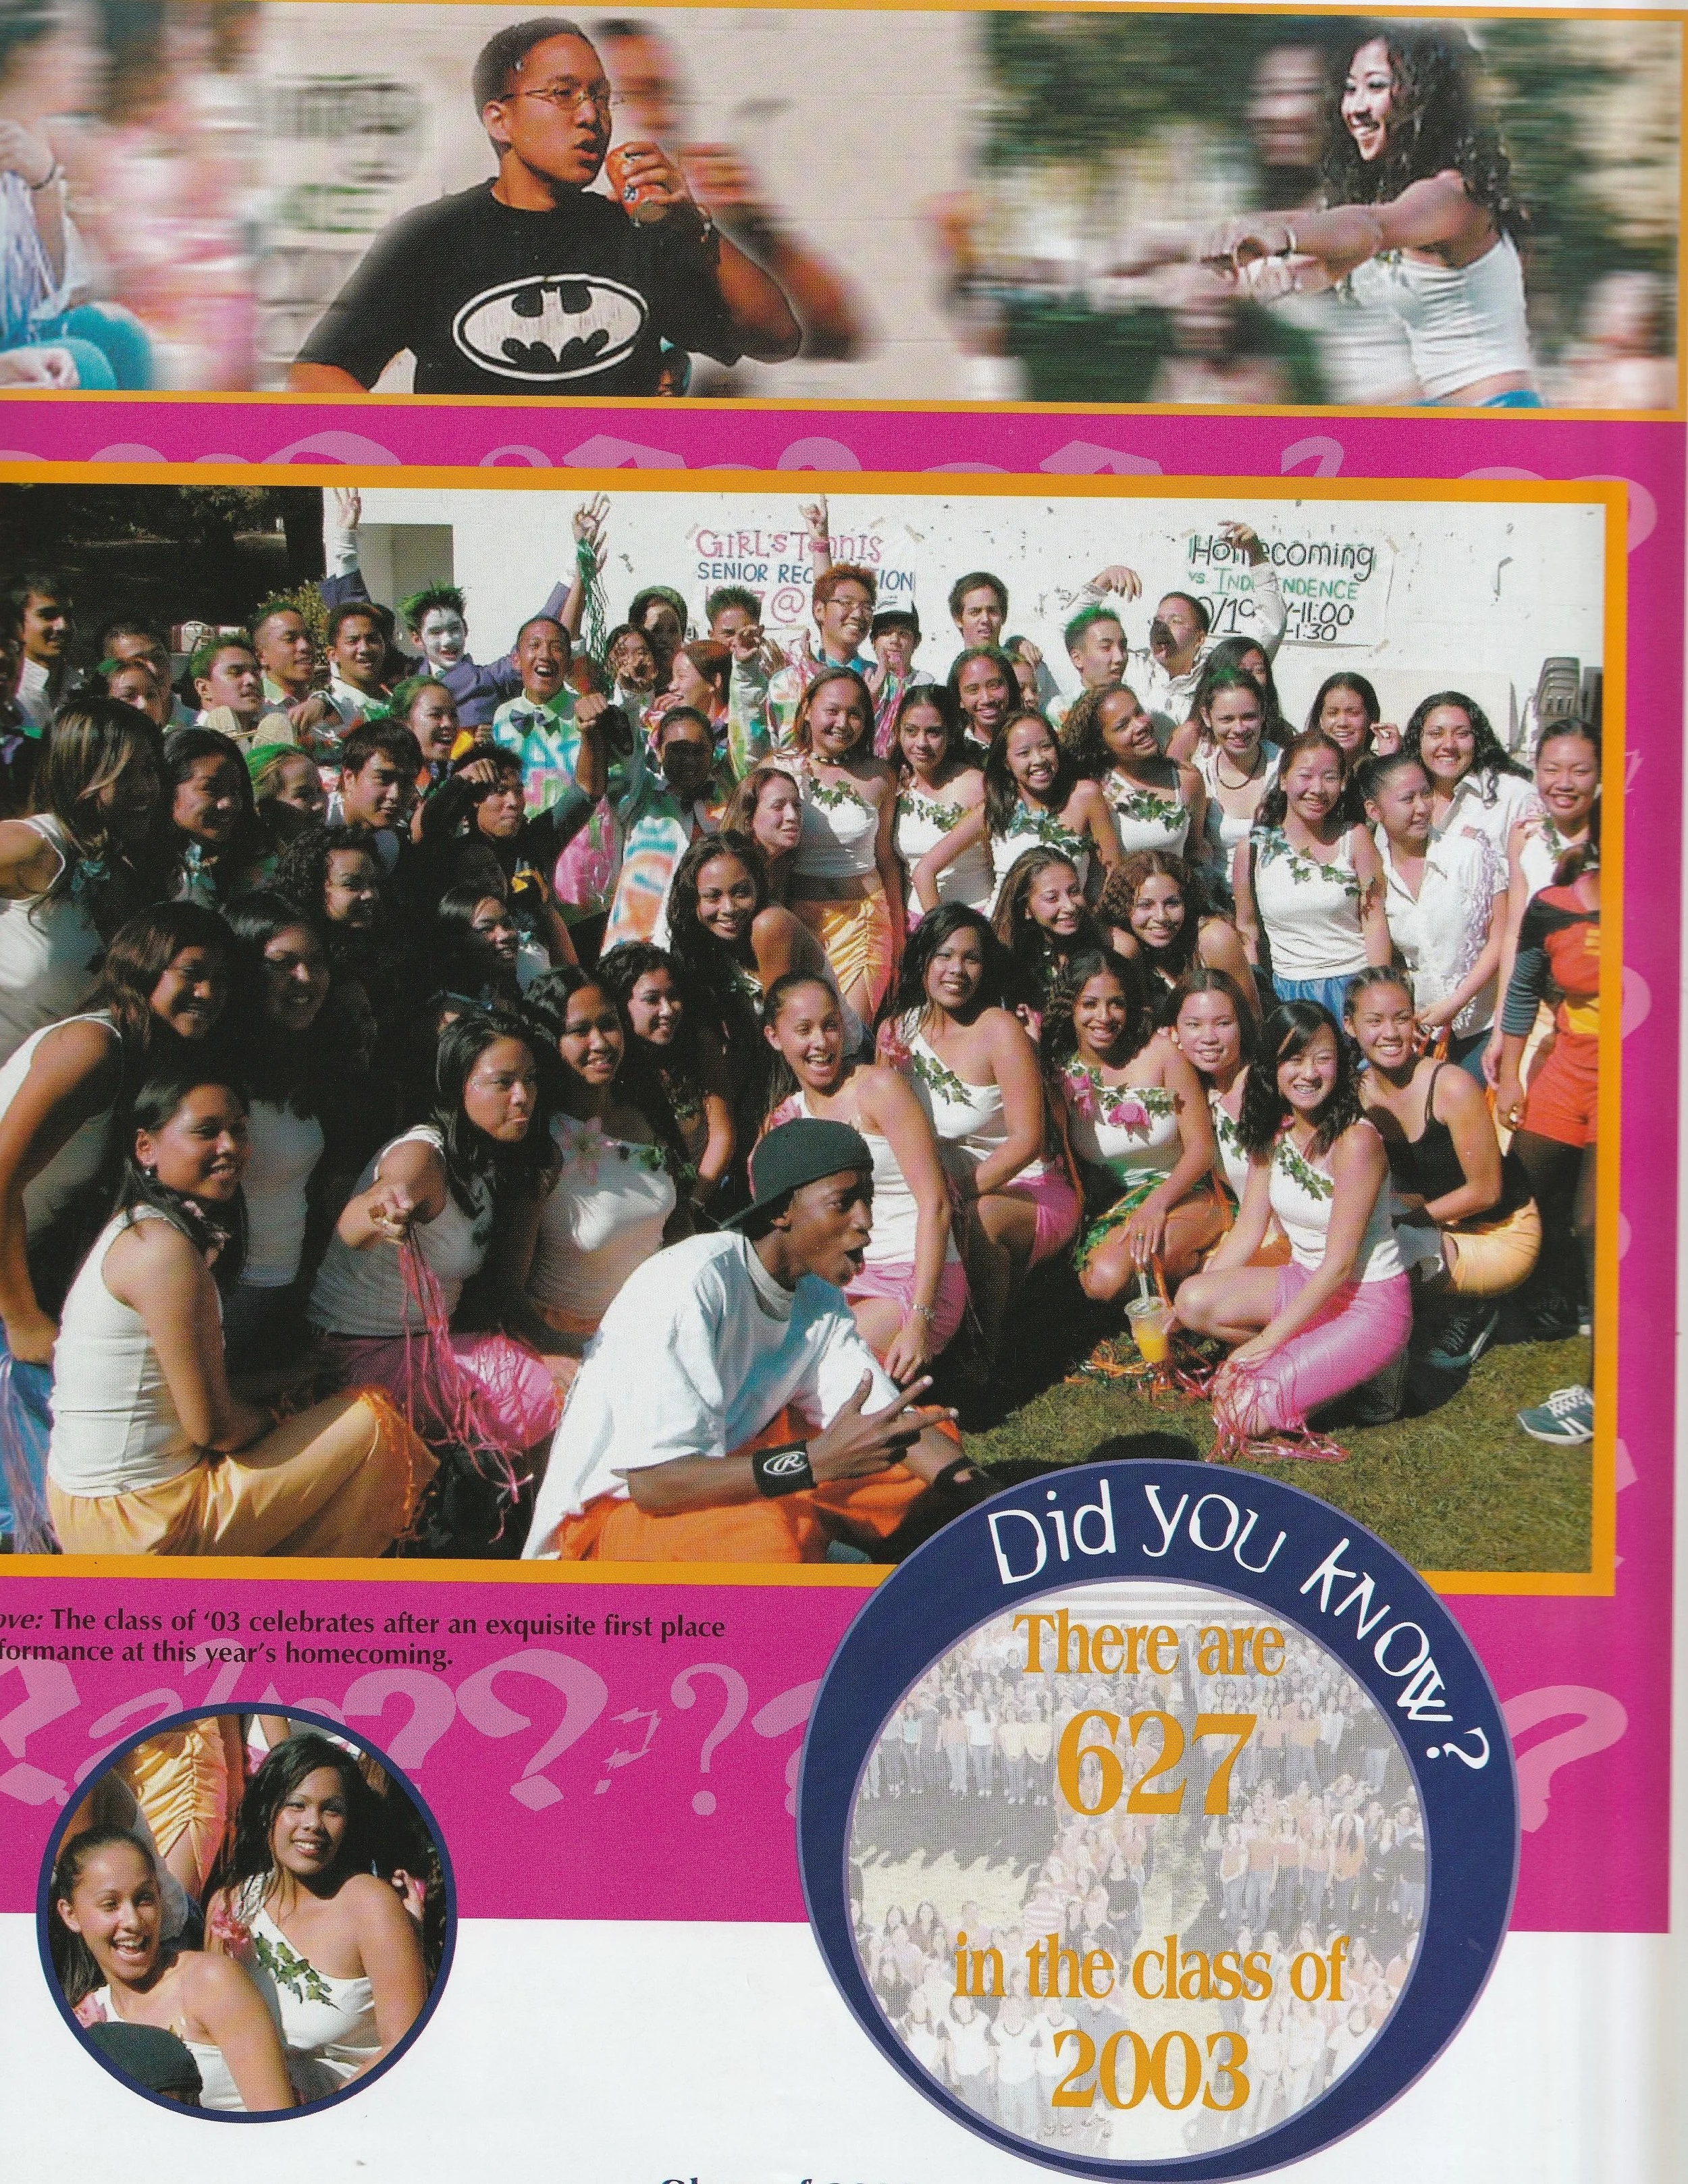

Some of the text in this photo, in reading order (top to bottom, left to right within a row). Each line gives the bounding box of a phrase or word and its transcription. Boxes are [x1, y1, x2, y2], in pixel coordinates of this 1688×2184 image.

[697, 562, 768, 583] SENIOR
[1211, 566, 1362, 601] INDNDENCE
[988, 1479, 1116, 1584] Did
[1142, 1485, 1286, 1574] you
[51, 1607, 96, 1630] The
[104, 1607, 163, 1630] class
[171, 1609, 197, 1630] of
[249, 1609, 375, 1633] celebrates
[384, 1611, 440, 1634] after
[448, 1618, 477, 1634] an
[485, 1613, 596, 1643] exquisite
[604, 1613, 653, 1636] first
[661, 1614, 726, 1644] place
[122, 1642, 144, 1661] at
[153, 1639, 196, 1662] this
[286, 1641, 453, 1672] homecoming.
[1013, 1608, 1286, 1676] There are
[1057, 1709, 1258, 1817] 627
[953, 1930, 1350, 2002] in the class of
[1051, 2029, 1251, 2112] 2003
